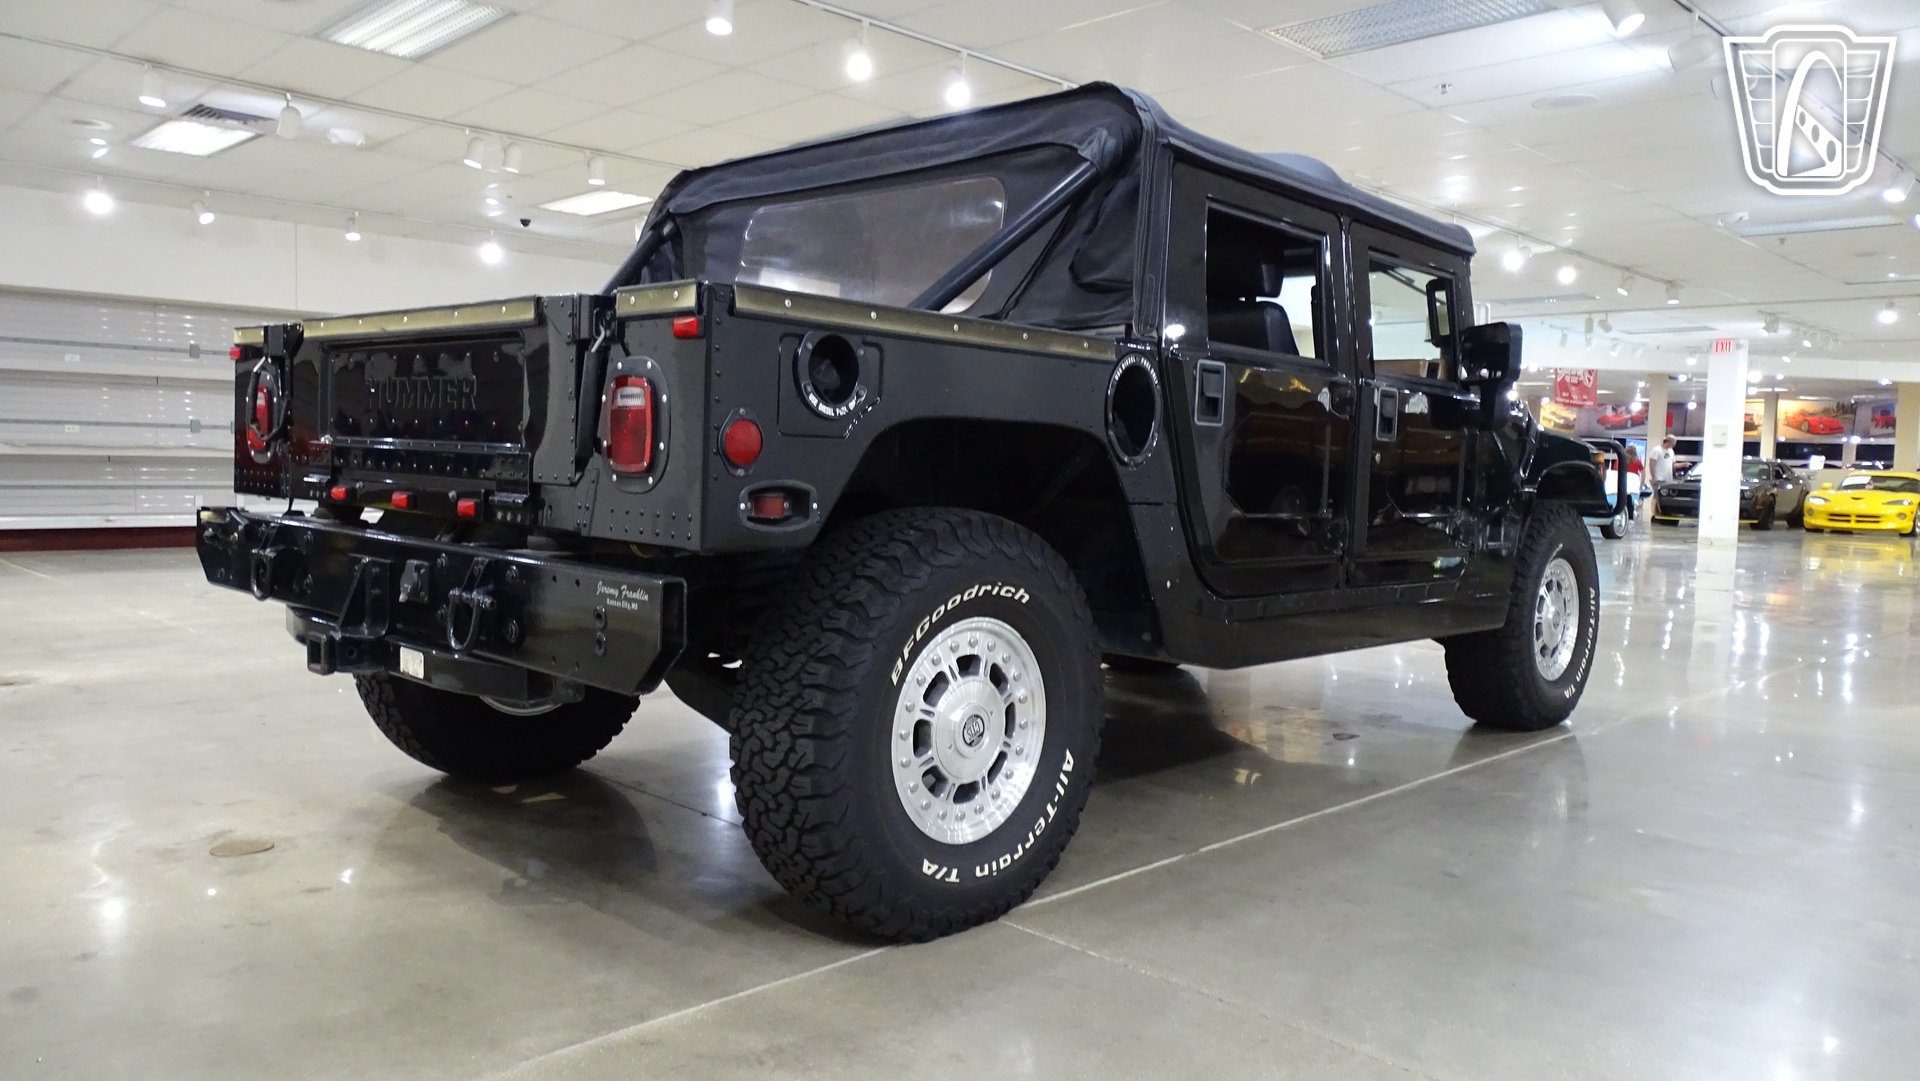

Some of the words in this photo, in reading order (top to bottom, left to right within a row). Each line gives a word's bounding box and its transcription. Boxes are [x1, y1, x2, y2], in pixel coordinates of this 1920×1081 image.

[1715, 340, 1733, 353] EXIT
[368, 374, 477, 411] HUMMER
[596, 580, 619, 599] Jeremy
[620, 584, 649, 602] Franklin
[606, 598, 621, 607] Kansas
[889, 581, 1031, 687] BFGoodrich
[1575, 586, 1596, 683] All-Terrain
[1563, 683, 1576, 699] T/A
[975, 748, 1076, 879] All-Terrain
[921, 858, 960, 883] T/A
